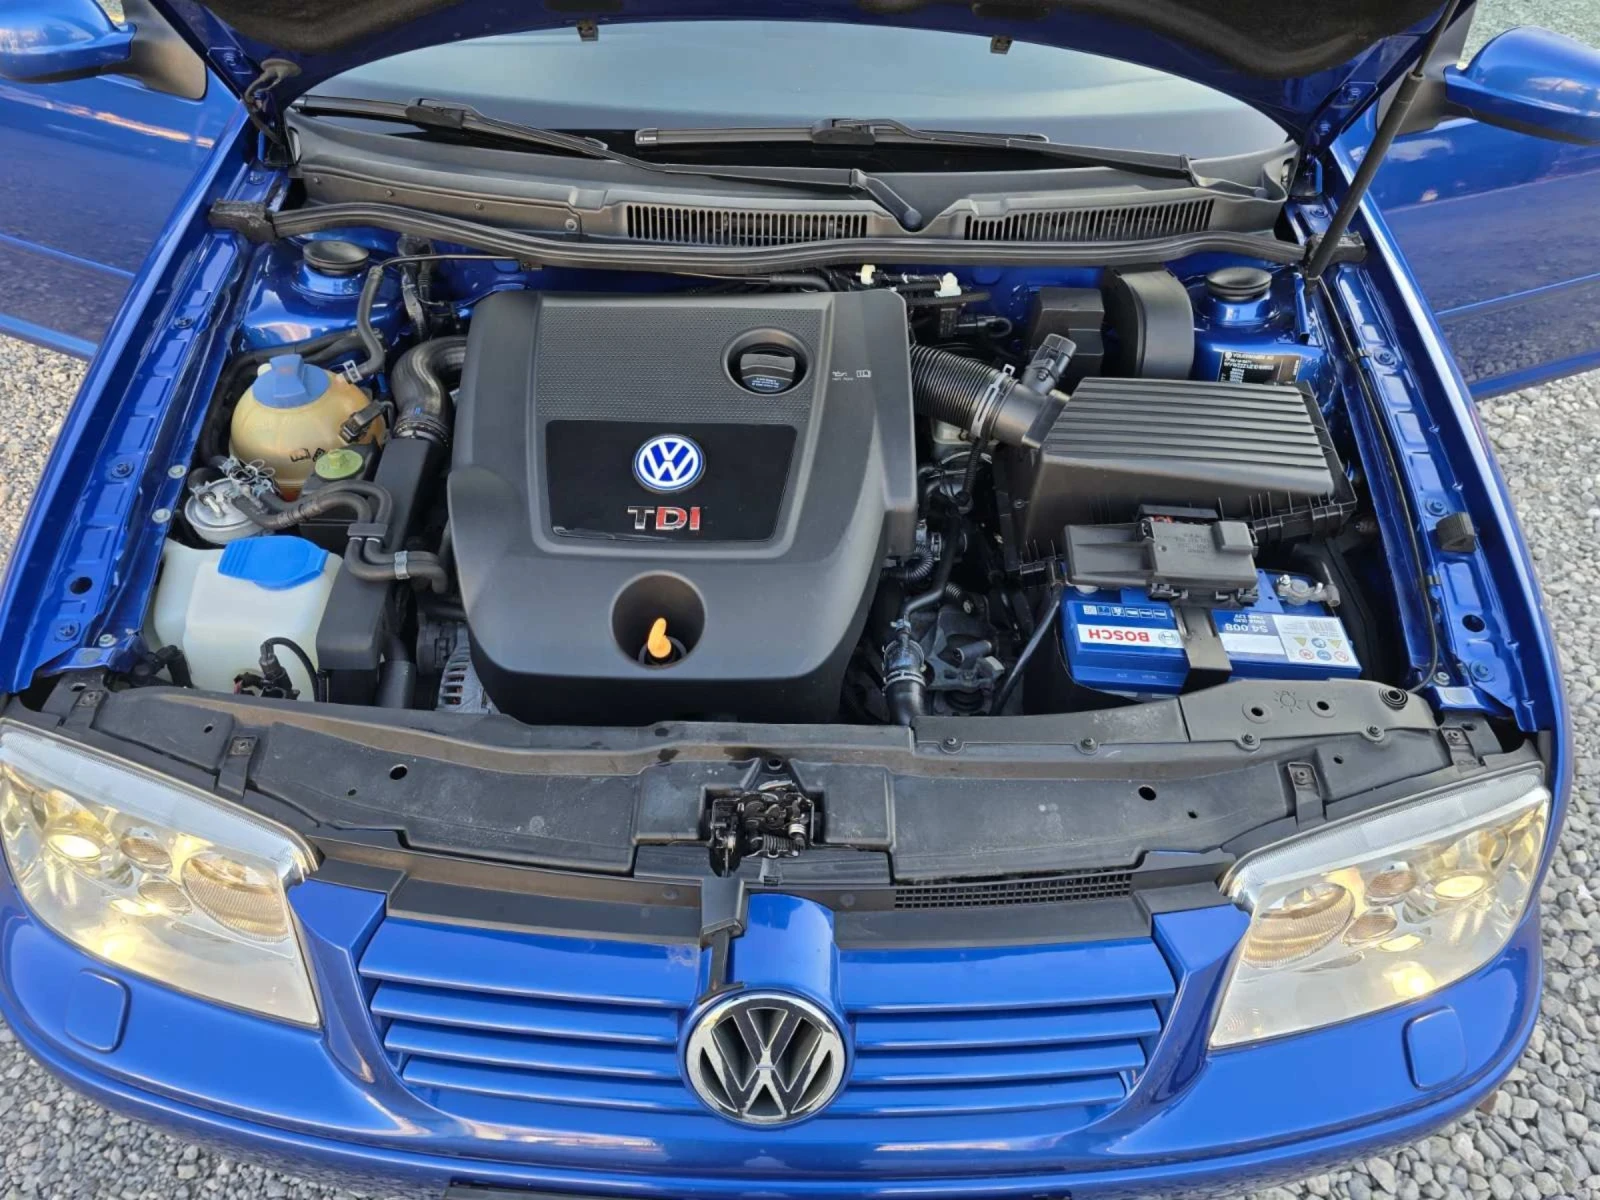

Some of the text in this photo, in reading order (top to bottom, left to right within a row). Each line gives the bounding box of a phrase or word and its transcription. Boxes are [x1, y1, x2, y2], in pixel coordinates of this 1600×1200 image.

[627, 506, 700, 531] TDI
[1088, 629, 1151, 642] BOSCH
[1251, 625, 1269, 633] S4
